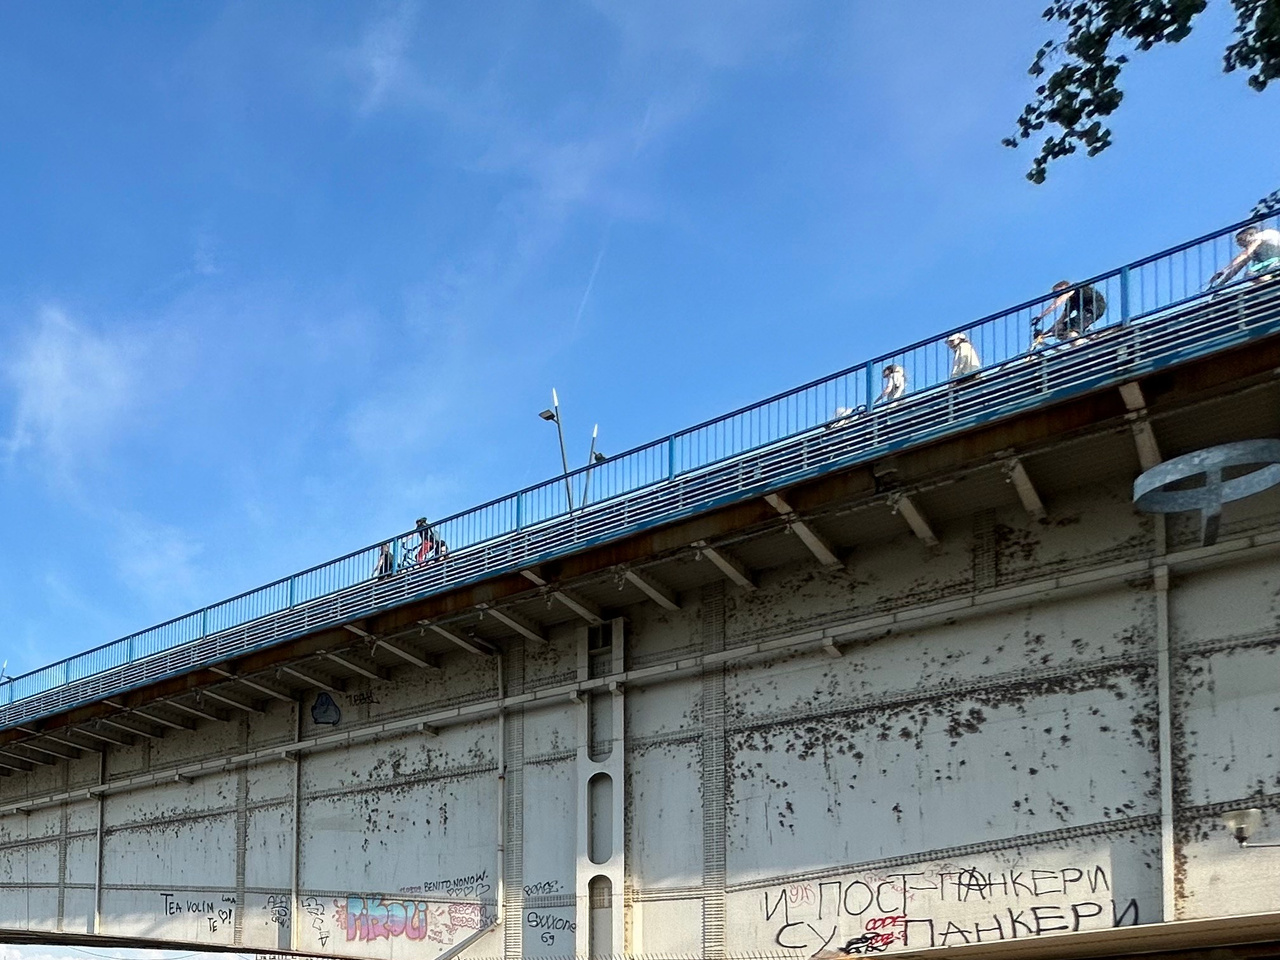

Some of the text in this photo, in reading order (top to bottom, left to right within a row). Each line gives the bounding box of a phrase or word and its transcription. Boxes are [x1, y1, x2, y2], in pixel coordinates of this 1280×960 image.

[160, 893, 214, 915] TEA VOLIM
[765, 888, 789, 925] И
[207, 917, 218, 932] TE
[776, 921, 837, 958] СУ
[904, 899, 1140, 947] ПАНКЕРИ
